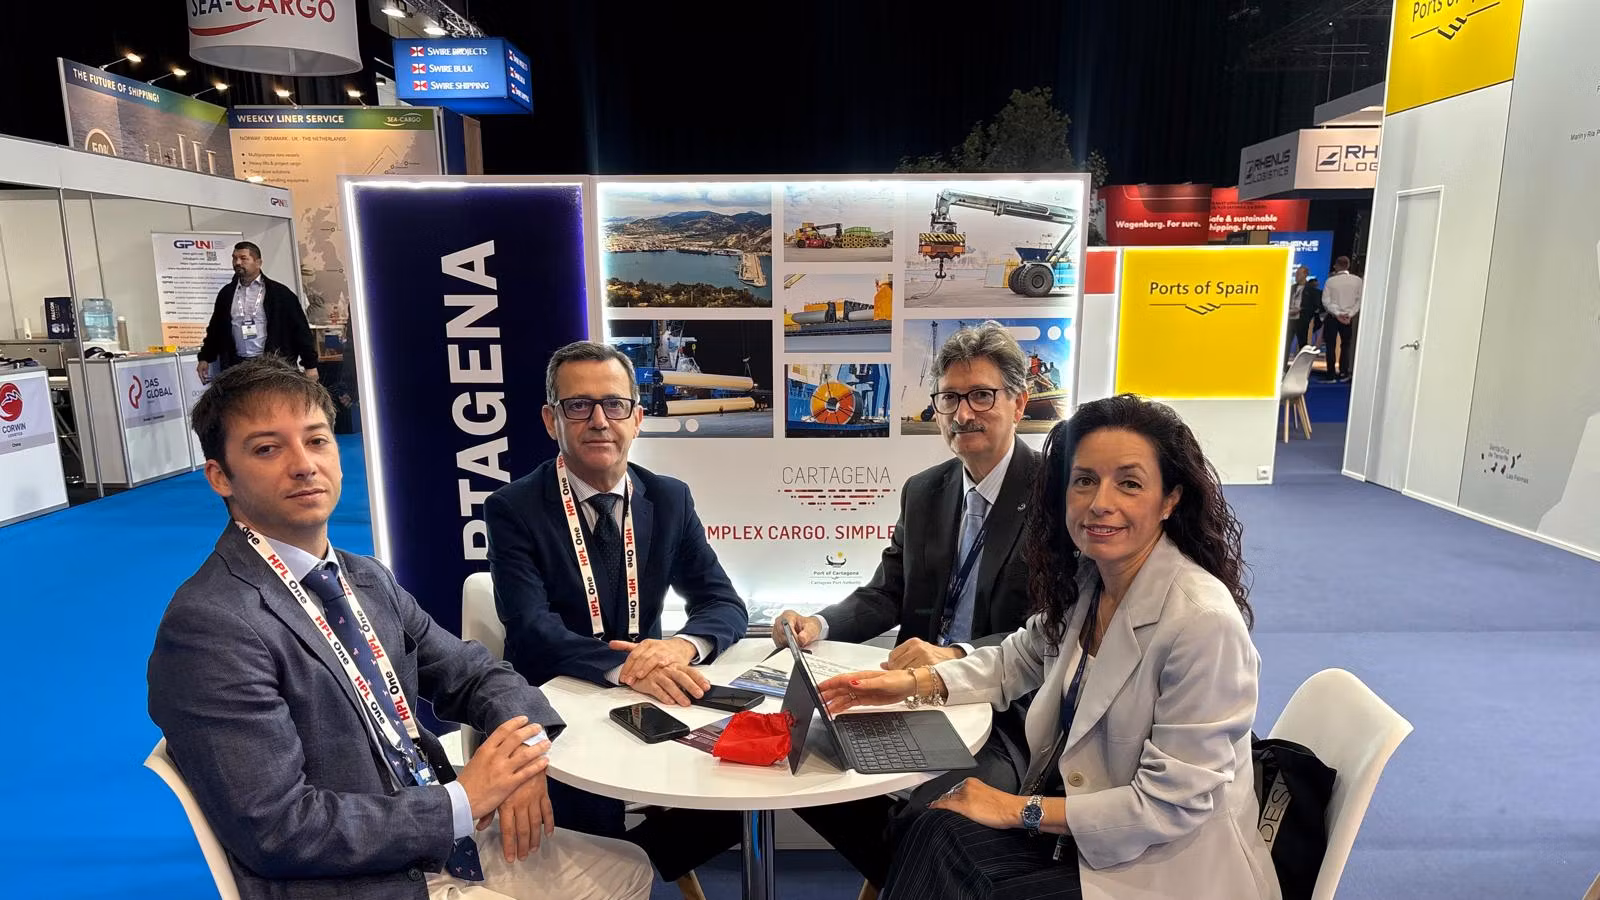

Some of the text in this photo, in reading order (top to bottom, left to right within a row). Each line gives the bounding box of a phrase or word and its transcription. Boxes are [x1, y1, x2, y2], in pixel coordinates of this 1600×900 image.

[1412, 0, 1442, 22] Ports
[452, 47, 488, 56] PROJECTS
[429, 64, 474, 73] SWIRE BULK
[72, 68, 160, 103] THE FUTURE OF SHIPPING!
[430, 82, 490, 90] SWIRE SHIPPING
[237, 115, 344, 123] WEEKLY LINER SERVICE
[1254, 149, 1291, 171] RHENUS
[1345, 145, 1379, 159] RH
[1343, 162, 1378, 172] LOG
[1115, 219, 1165, 230] Wagenborg.
[1166, 219, 1180, 228] For
[1208, 214, 1225, 222] afe
[1233, 214, 1278, 222] sustainable
[1149, 280, 1259, 299] Ports of Spain
[144, 378, 160, 388] DAS
[146, 387, 173, 399] GLOBAL
[2, 422, 26, 434] CORWIN
[782, 466, 891, 484] CARTAGENA
[562, 477, 576, 517] HPL One
[625, 528, 633, 548] HPL
[768, 526, 830, 540] CARGO.
[574, 527, 589, 567] HPL One
[267, 553, 307, 604] HPL One
[586, 576, 600, 617] HPL One
[628, 578, 637, 619] HPL One
[315, 615, 350, 666] HPL One
[356, 609, 384, 660] HPL One
[354, 675, 386, 726] HPL One
[385, 670, 411, 721] HPL One
